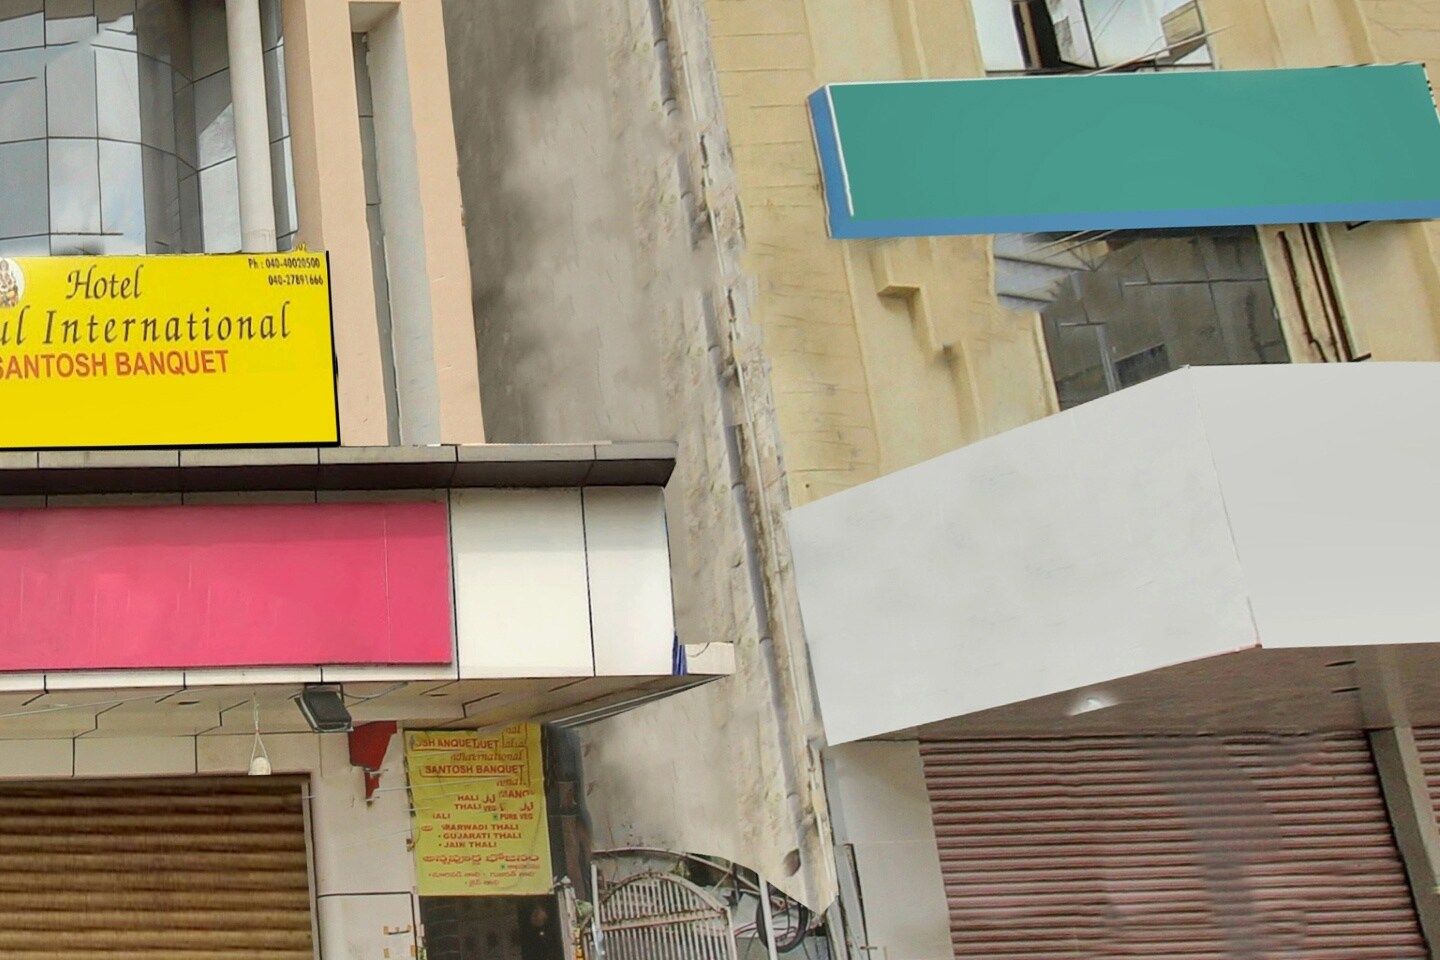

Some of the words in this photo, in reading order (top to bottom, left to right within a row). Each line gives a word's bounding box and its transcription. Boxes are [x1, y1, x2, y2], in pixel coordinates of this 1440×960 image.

[65, 264, 144, 300] Hotel
[42, 300, 291, 346] International
[115, 349, 229, 377] BANQUET
[424, 764, 473, 774] SANTOSH
[476, 764, 525, 774] BANQUET
